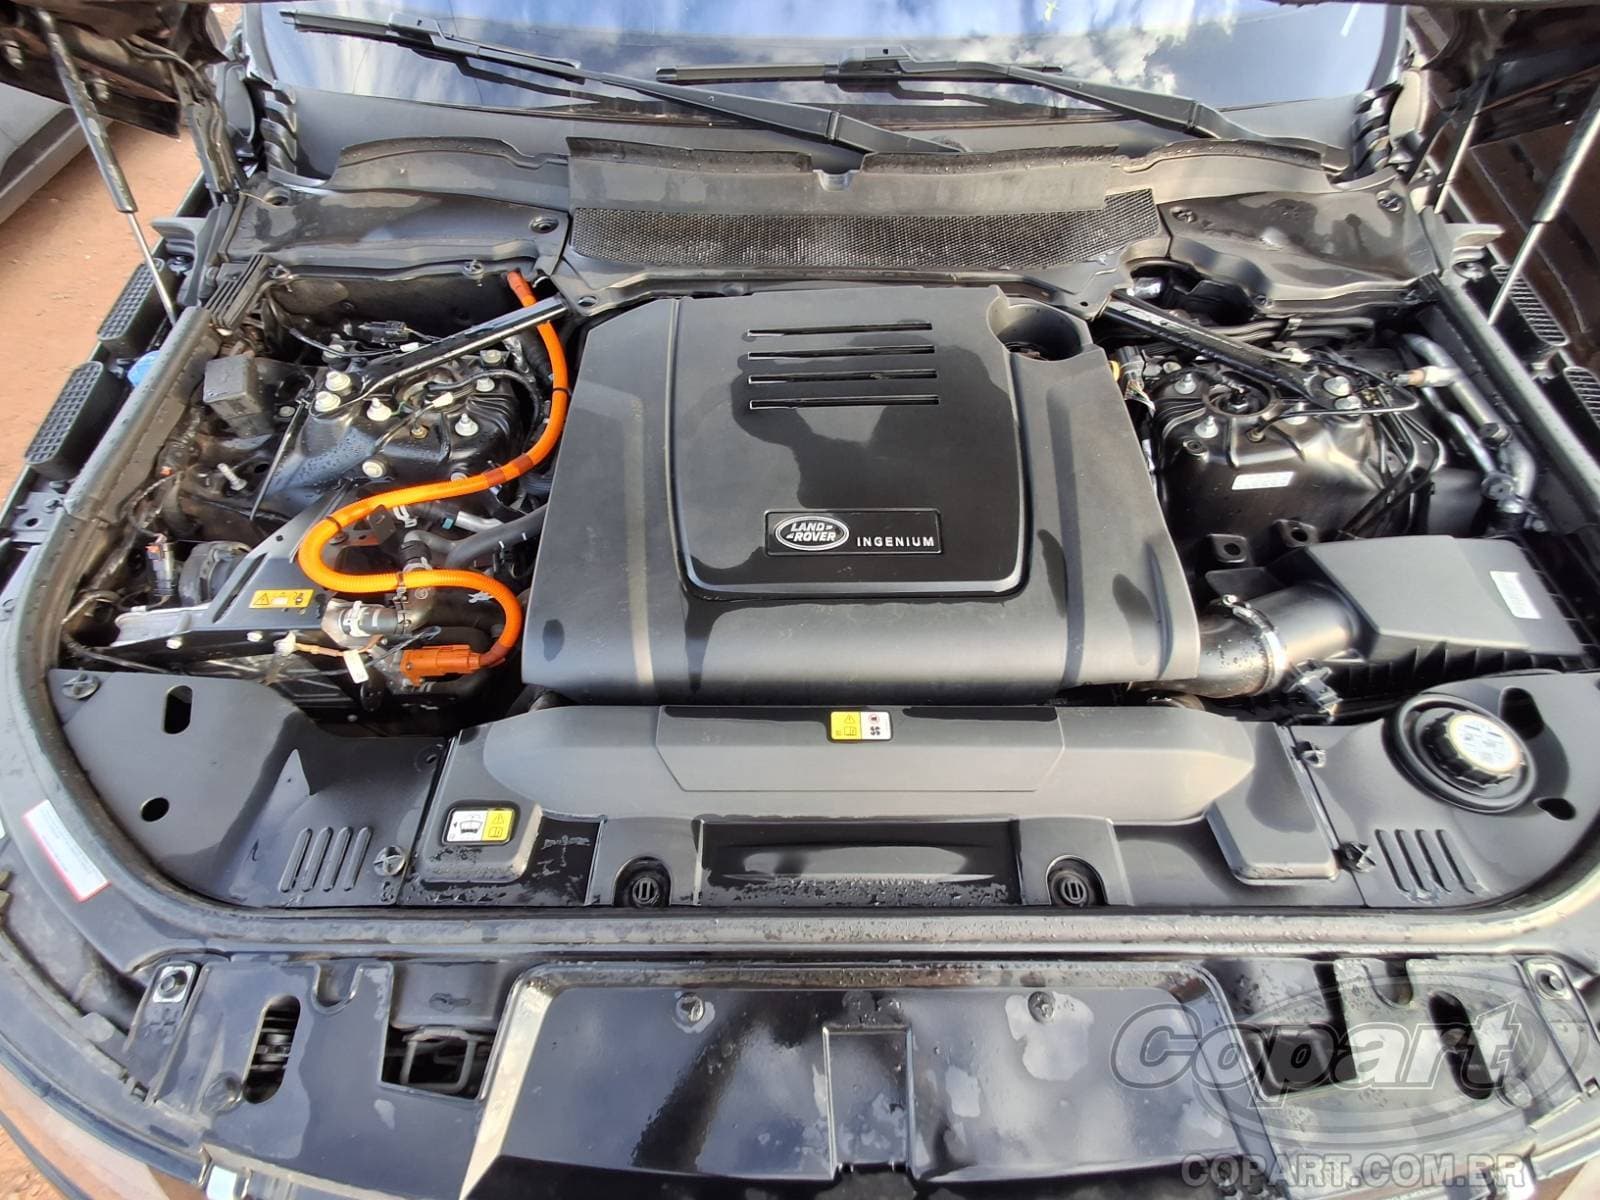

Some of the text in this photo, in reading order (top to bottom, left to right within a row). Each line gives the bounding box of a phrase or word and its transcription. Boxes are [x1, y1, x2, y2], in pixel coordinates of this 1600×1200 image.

[790, 522, 825, 531] LAND
[793, 531, 837, 542] ROVER
[856, 536, 935, 547] INGENIUM
